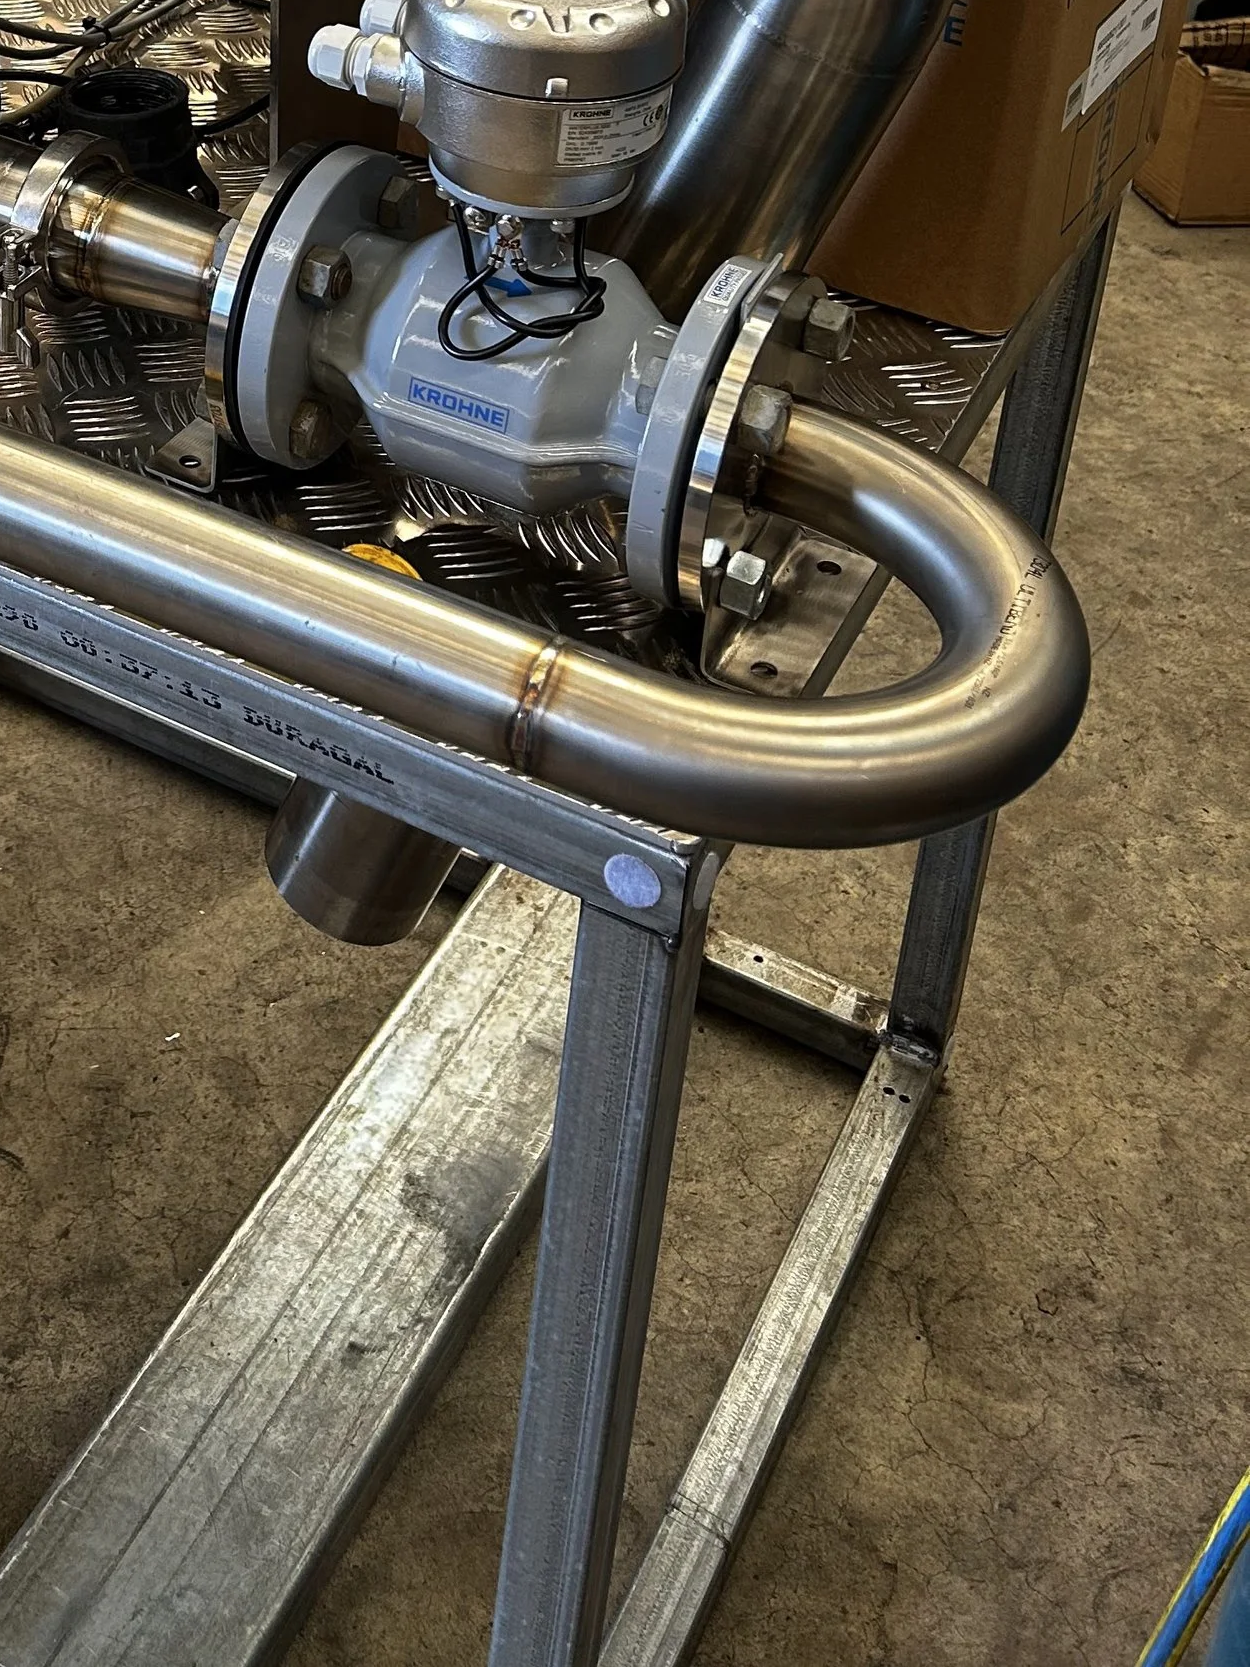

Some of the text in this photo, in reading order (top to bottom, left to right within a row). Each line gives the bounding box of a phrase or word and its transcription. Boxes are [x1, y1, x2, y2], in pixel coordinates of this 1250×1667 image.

[572, 109, 612, 118] KROHNE
[710, 267, 739, 298] KROHNE
[412, 383, 506, 428] KROHNE
[242, 705, 395, 785] DURAGAL
